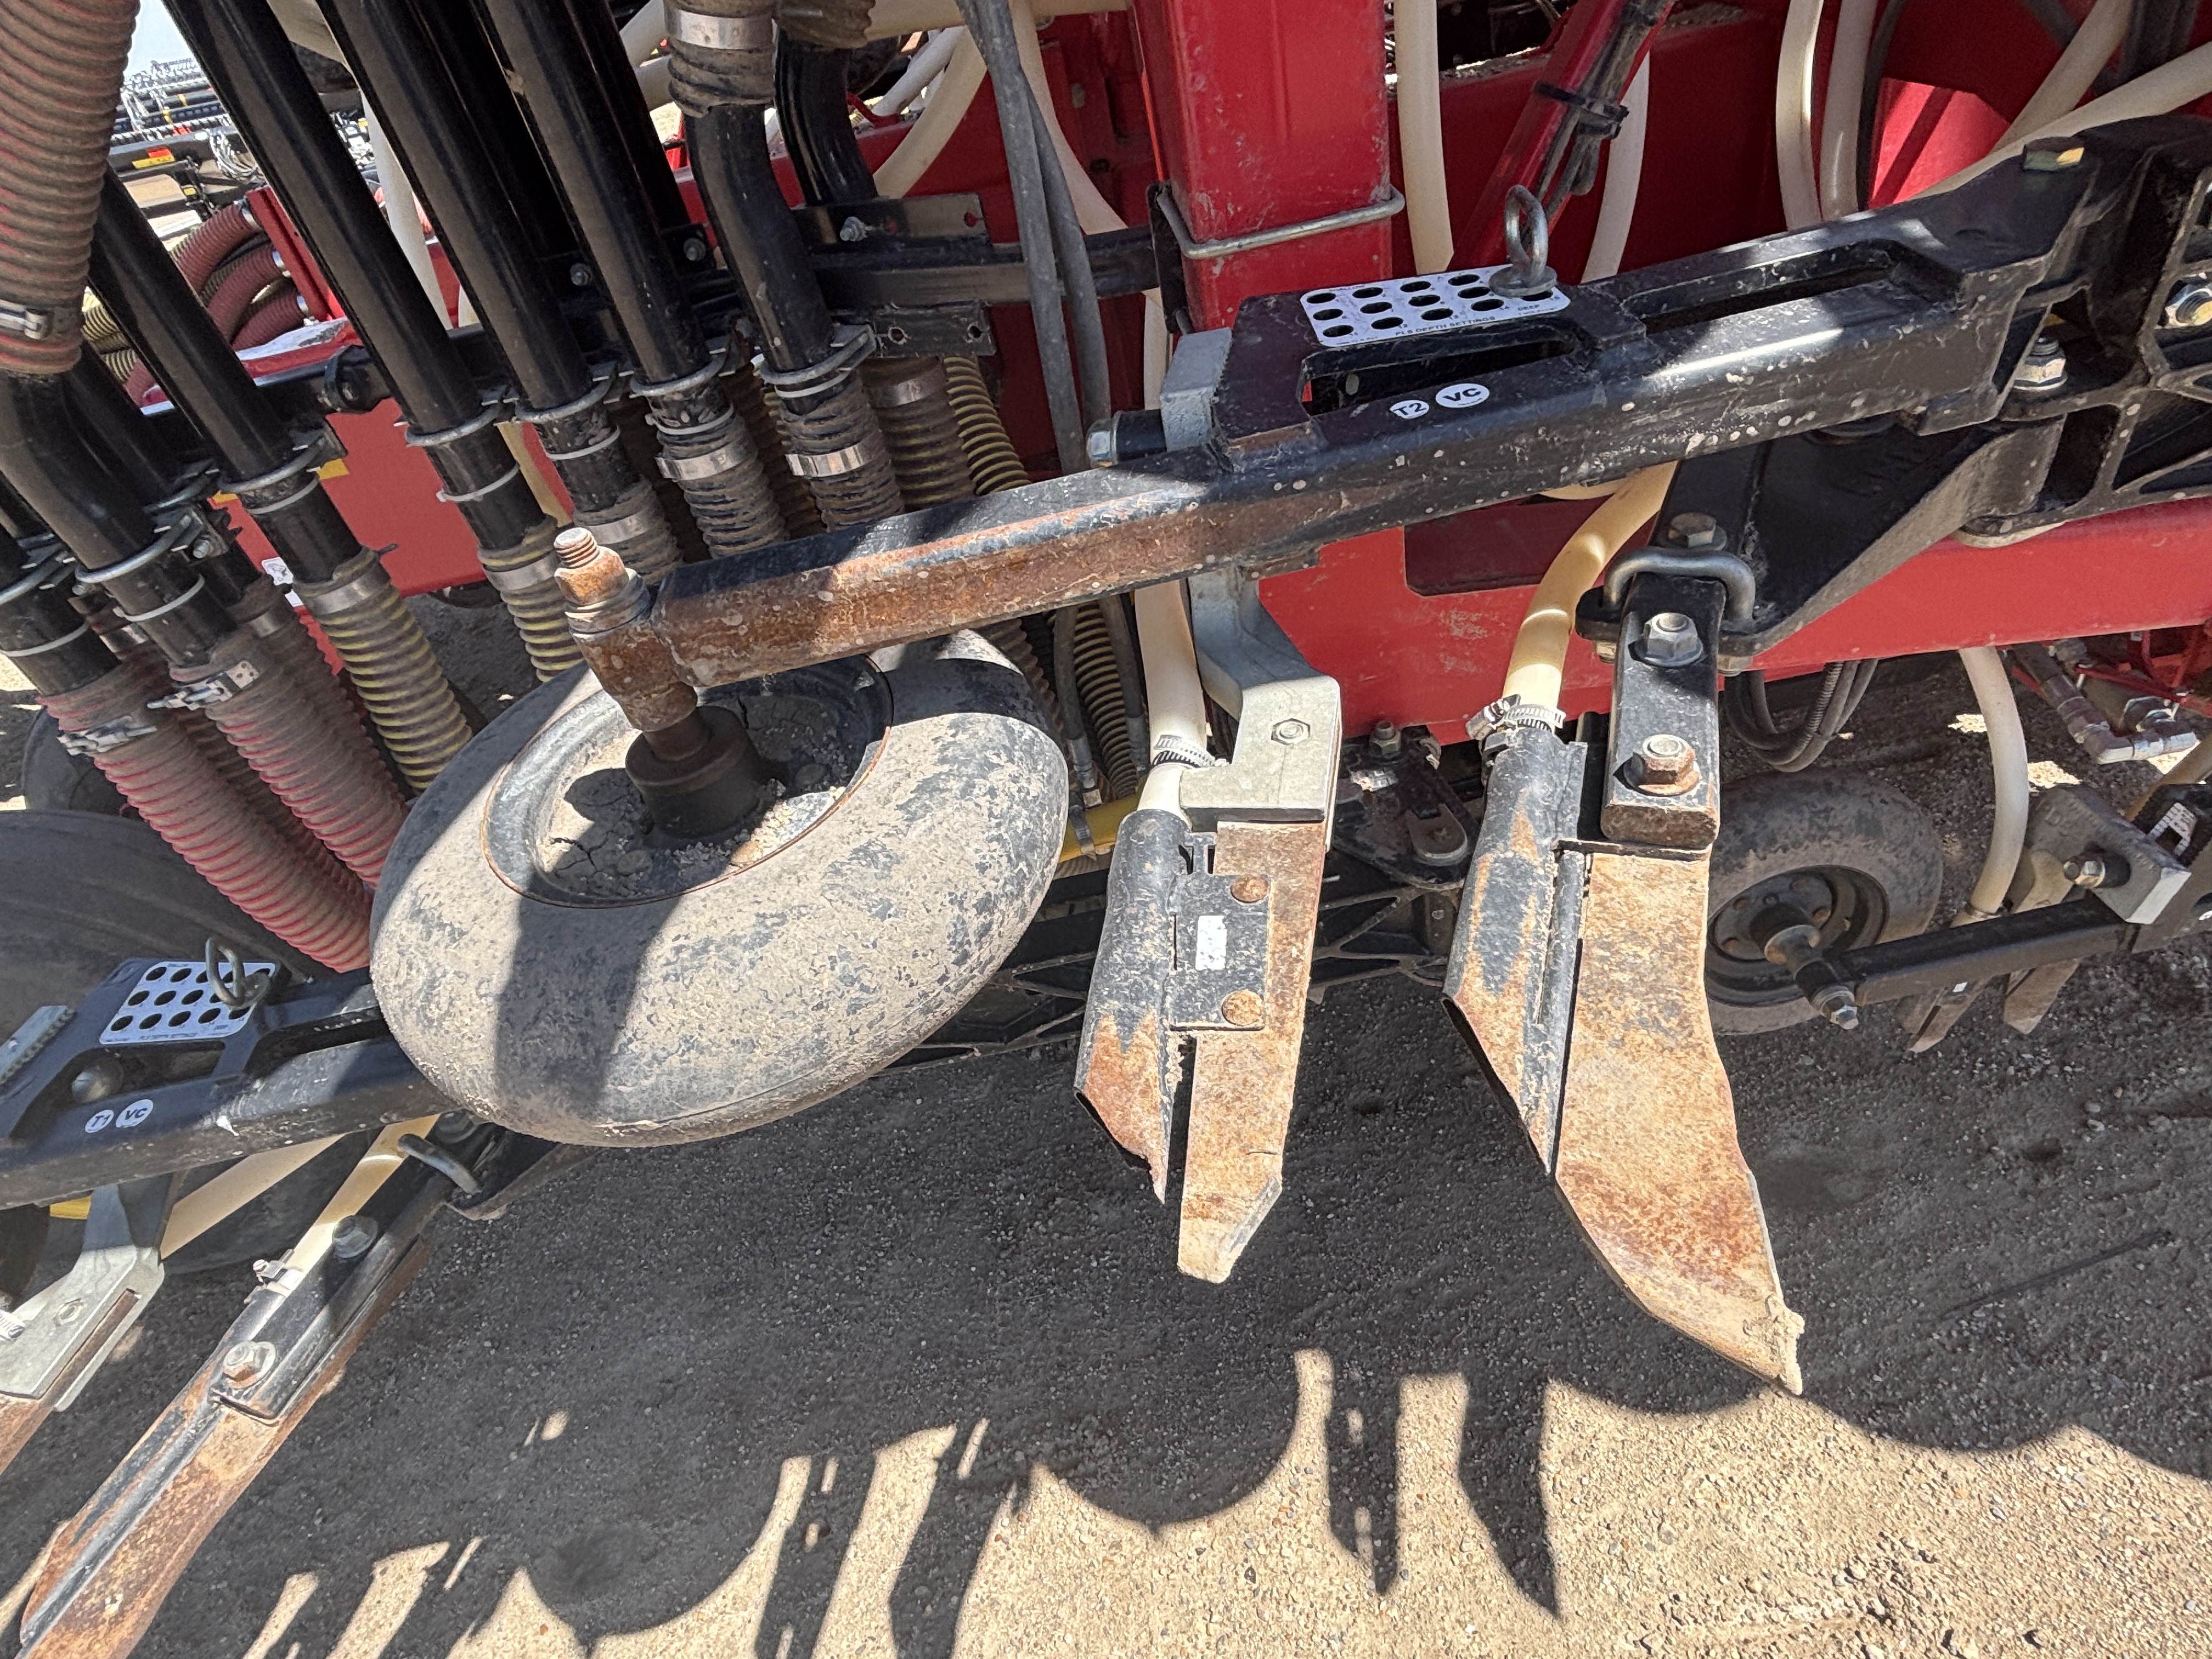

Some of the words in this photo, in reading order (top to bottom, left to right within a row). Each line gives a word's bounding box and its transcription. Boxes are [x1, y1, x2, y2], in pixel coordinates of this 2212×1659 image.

[1442, 388, 1481, 402] VC
[1392, 402, 1426, 416] T2
[91, 1114, 112, 1127] T1
[125, 1108, 148, 1120] VC
